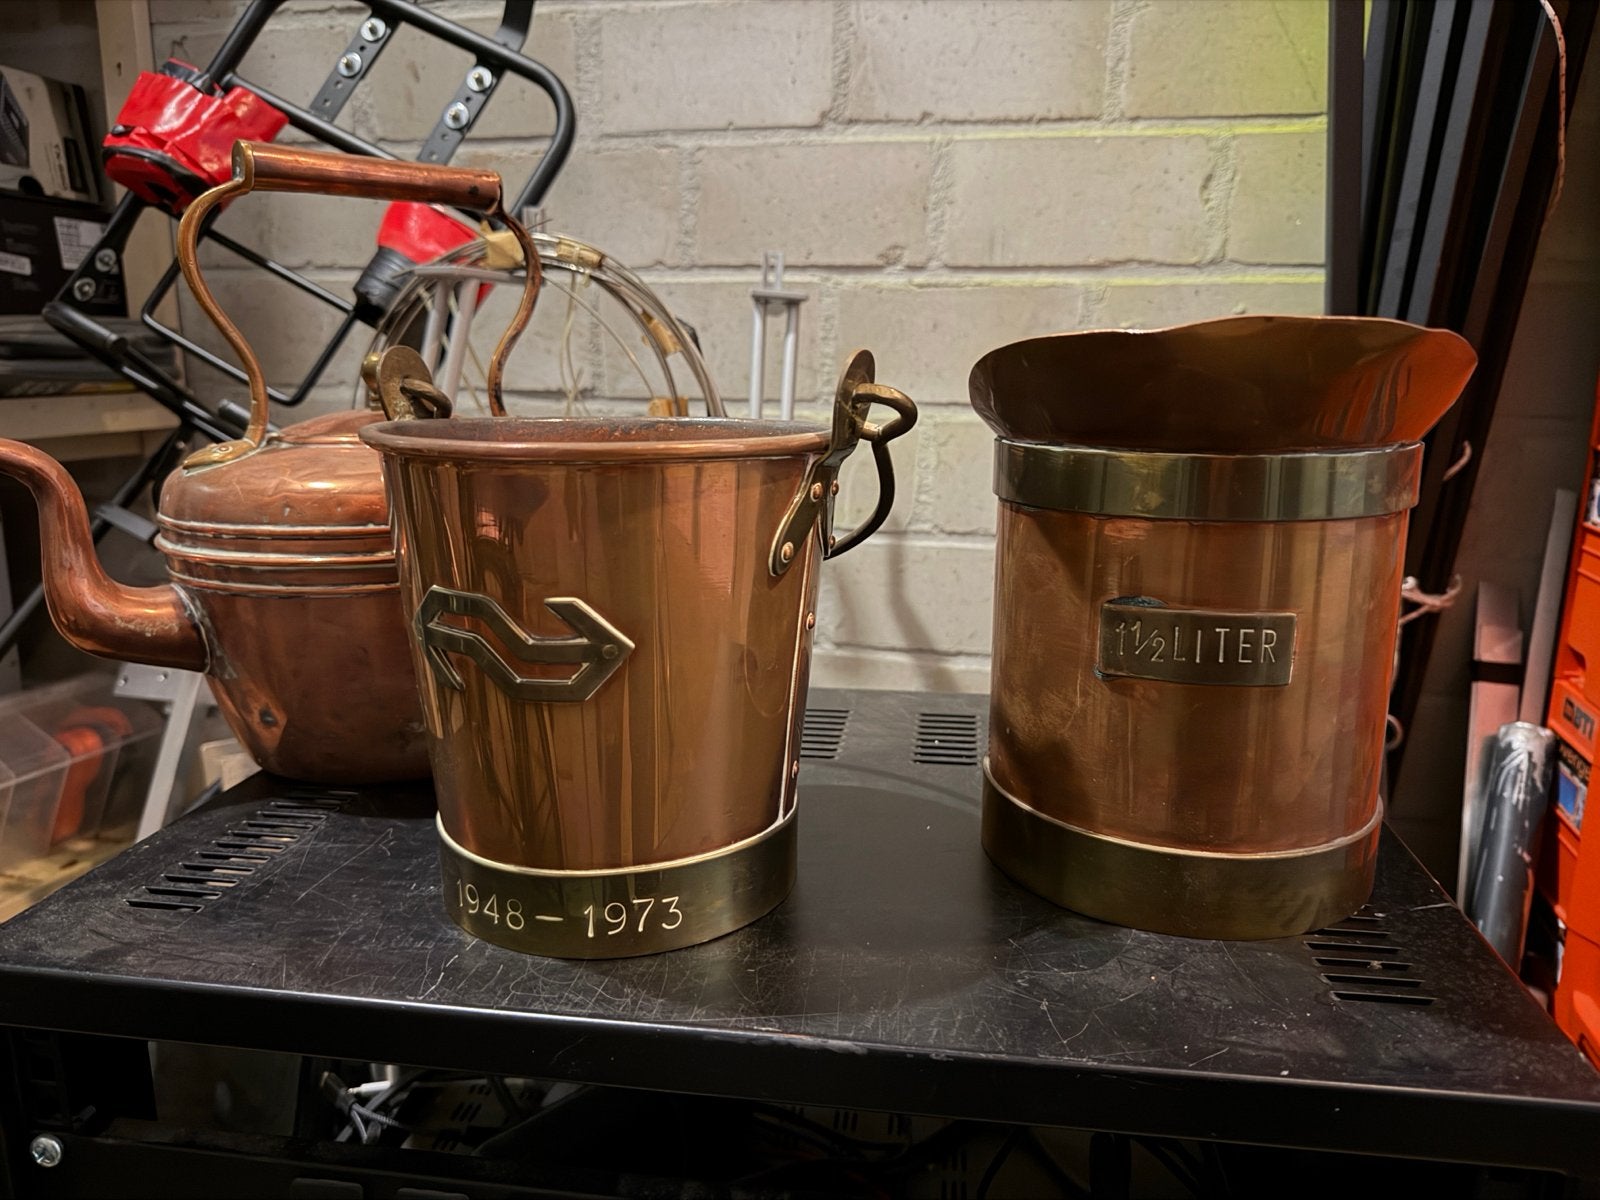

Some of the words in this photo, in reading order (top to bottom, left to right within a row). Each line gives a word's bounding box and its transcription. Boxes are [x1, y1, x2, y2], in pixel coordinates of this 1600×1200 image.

[1173, 626, 1278, 664] LITER
[456, 879, 525, 931] 1948
[583, 895, 684, 938] 1973
